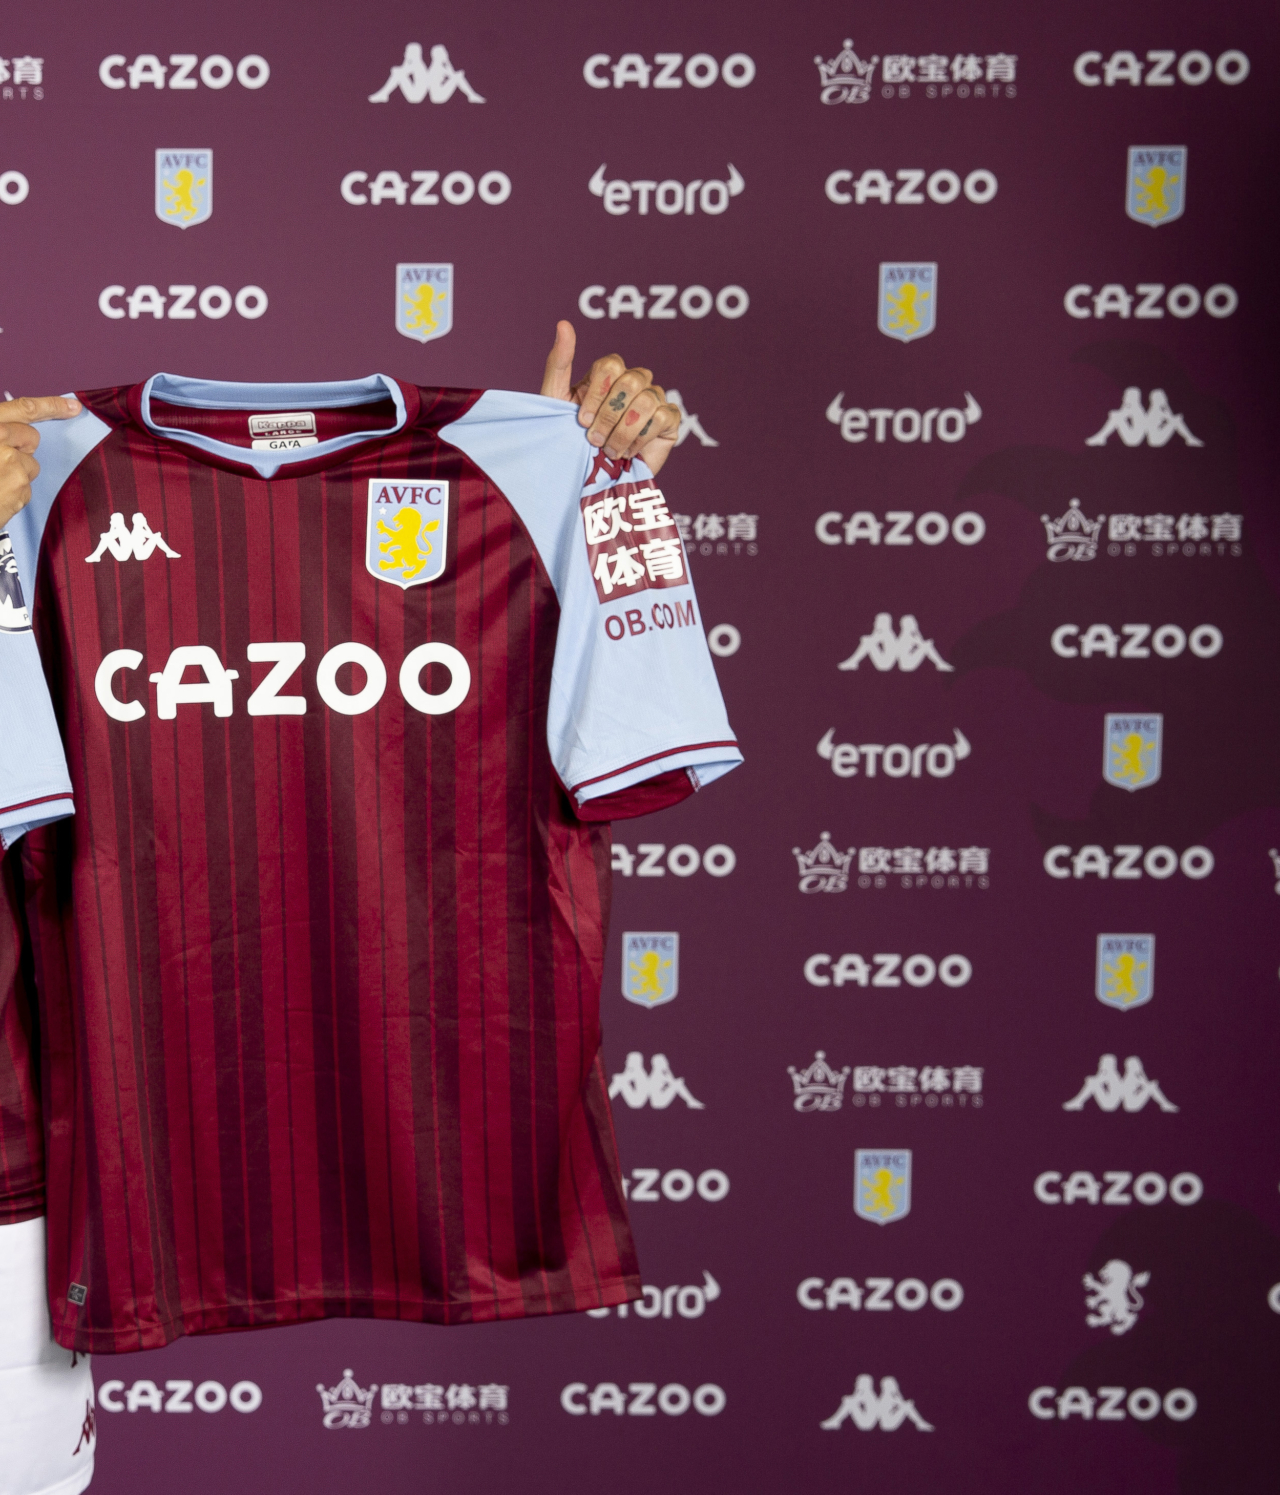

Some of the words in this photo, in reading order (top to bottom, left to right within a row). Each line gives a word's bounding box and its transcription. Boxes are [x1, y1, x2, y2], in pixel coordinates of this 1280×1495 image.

[99, 55, 269, 89] CAZOO
[583, 54, 755, 88] CAZOO
[1074, 51, 1249, 86] CAZOO
[341, 171, 511, 205] CAZOO
[825, 170, 997, 204] CAZOO
[99, 285, 268, 319] CAZOO
[579, 285, 749, 319] CAZOO
[1064, 284, 1237, 318] CAZOO
[375, 486, 442, 505] AVFC
[583, 488, 674, 545] 欧宝
[816, 512, 985, 545] CAZOO
[594, 538, 684, 595] 体育
[605, 600, 696, 641] OB.COM
[1051, 624, 1222, 657] CAZOO
[95, 640, 471, 722] CAZOO
[611, 844, 736, 877] AZOO
[1044, 845, 1214, 878] CAZOO
[804, 954, 971, 986] CAZOO
[622, 1168, 730, 1201] ZOO
[1034, 1171, 1202, 1205] CAZOO
[797, 1278, 963, 1310] CAZOO
[98, 1380, 262, 1412] CAZOO
[561, 1383, 725, 1415] CAZOO
[1029, 1387, 1196, 1420] CAZOO
